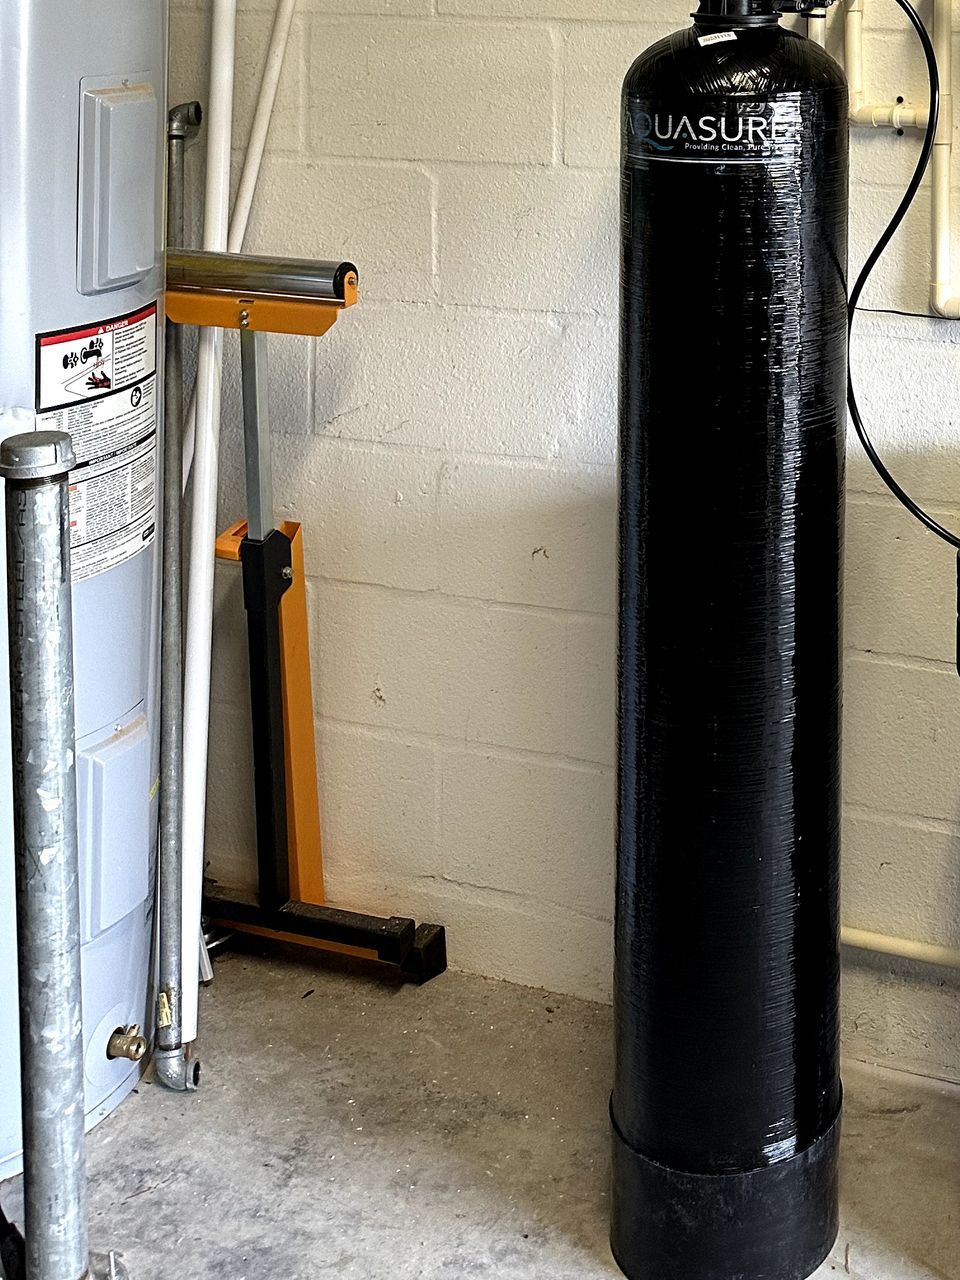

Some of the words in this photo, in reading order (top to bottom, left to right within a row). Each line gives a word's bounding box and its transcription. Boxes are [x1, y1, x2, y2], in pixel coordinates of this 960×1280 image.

[684, 142, 720, 151] Providing
[721, 143, 746, 152] Clean,
[105, 320, 129, 332] DANGER
